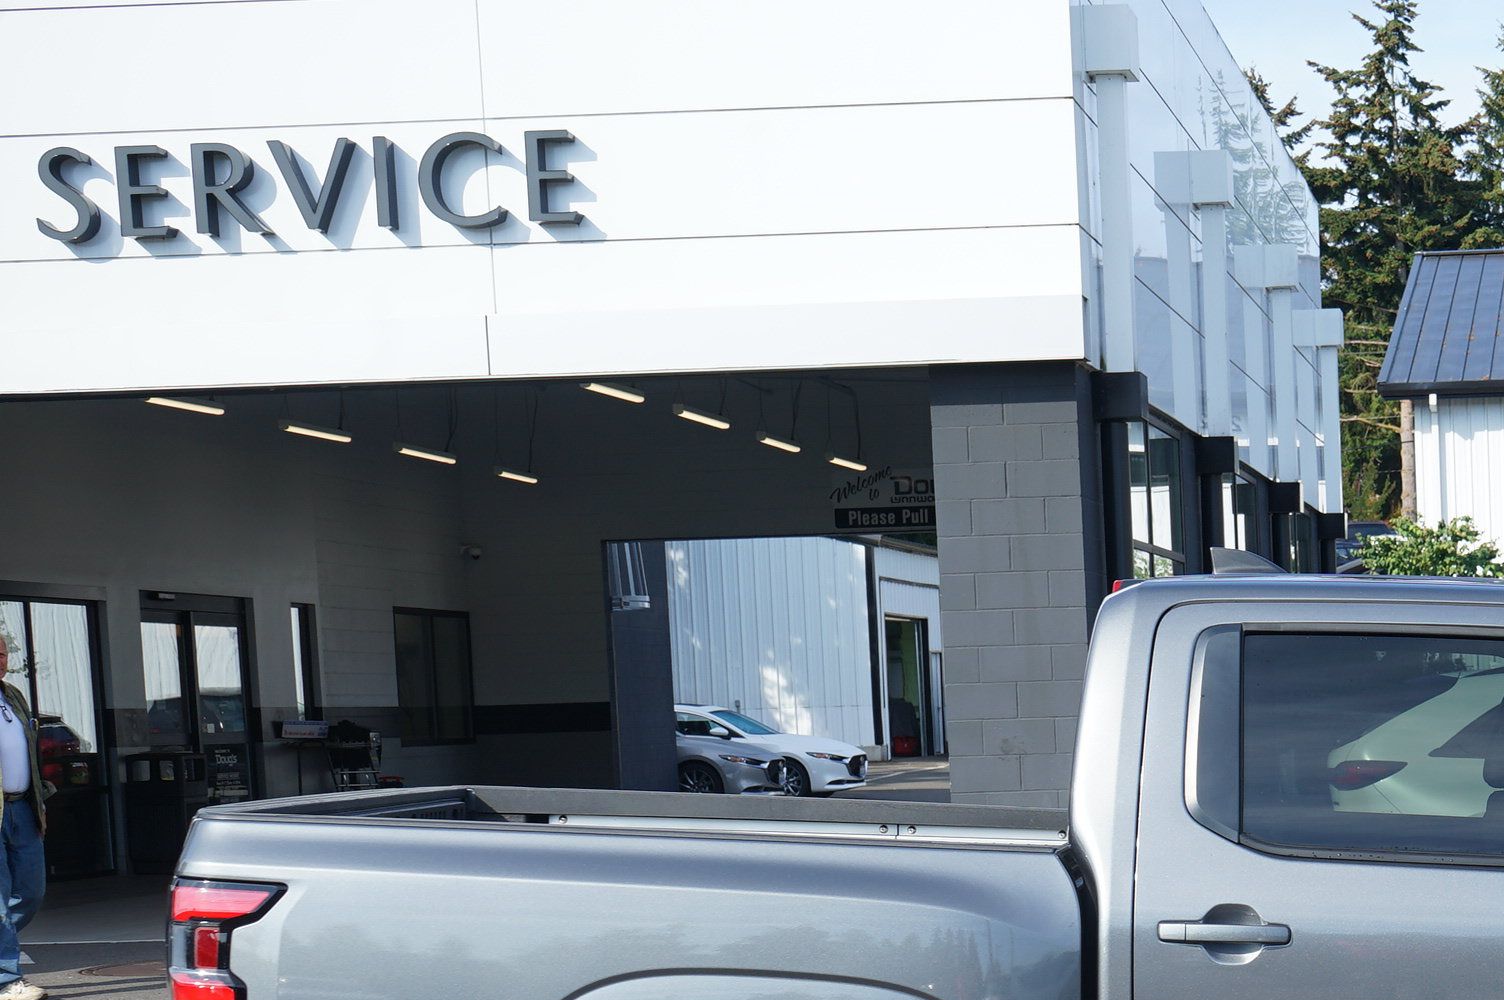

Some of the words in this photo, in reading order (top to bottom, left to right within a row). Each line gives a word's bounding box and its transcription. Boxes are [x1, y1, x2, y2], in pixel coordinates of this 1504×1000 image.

[35, 129, 587, 244] SERVICE
[829, 465, 893, 503] Welcome
[868, 488, 880, 501] to
[848, 510, 896, 526] Please
[902, 508, 929, 524] Pull
